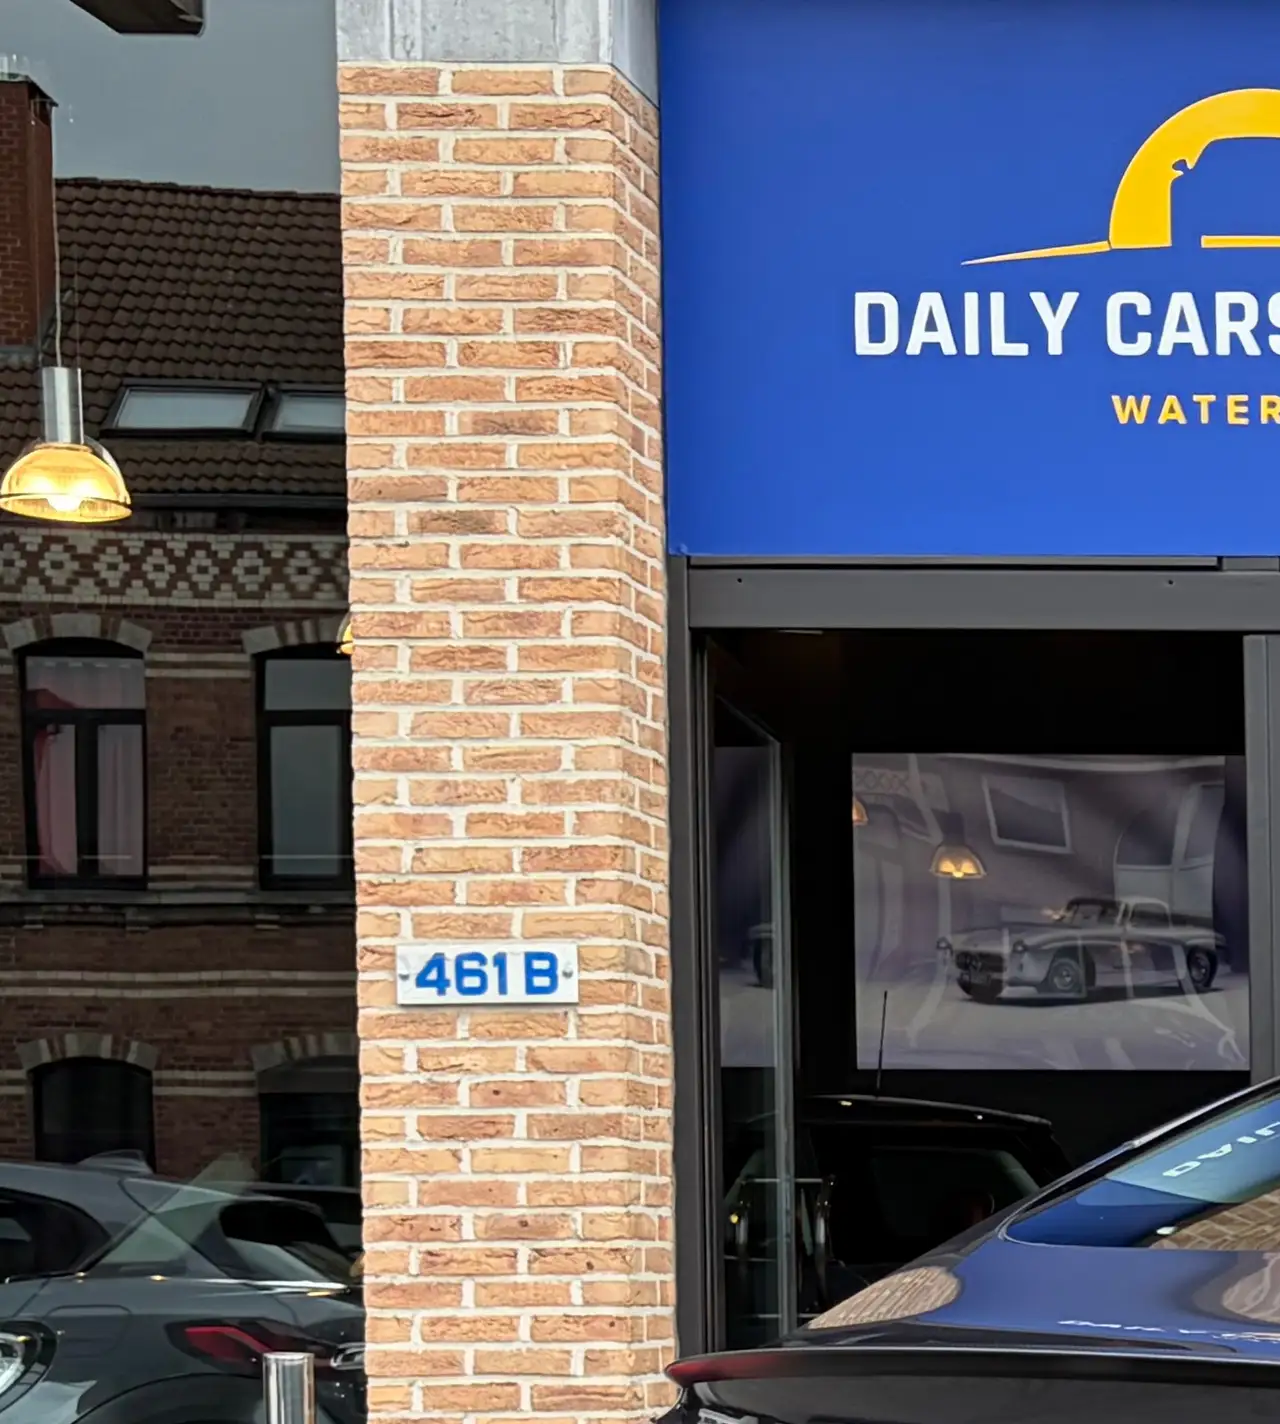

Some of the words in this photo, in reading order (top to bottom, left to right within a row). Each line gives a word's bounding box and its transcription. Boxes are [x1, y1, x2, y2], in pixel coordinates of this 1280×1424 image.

[852, 290, 1079, 356] DAILY
[415, 952, 507, 996] 461
[524, 951, 559, 996] B
